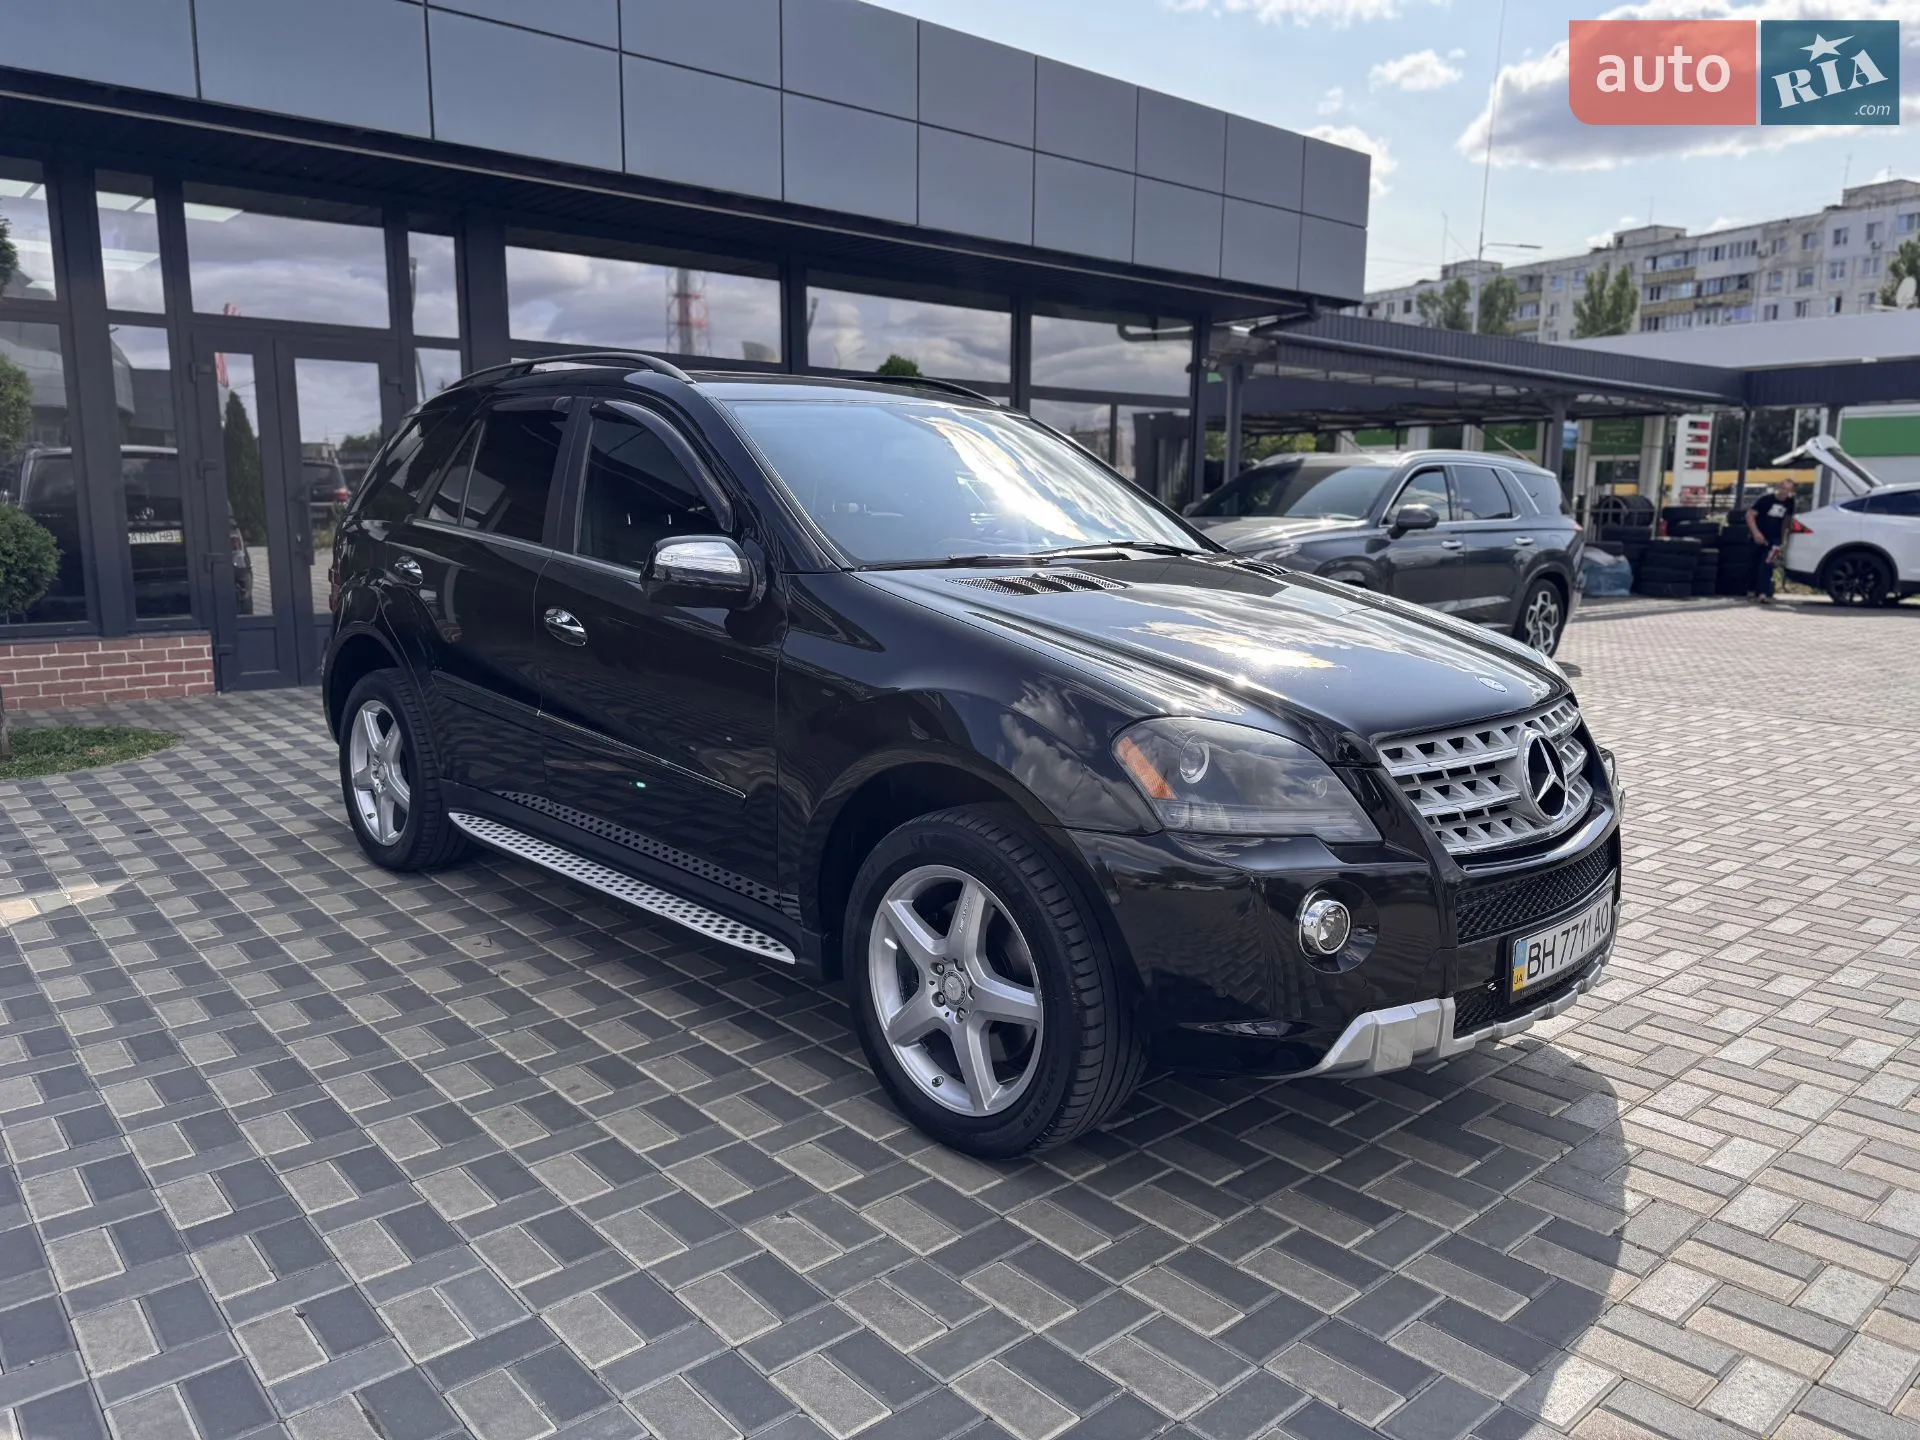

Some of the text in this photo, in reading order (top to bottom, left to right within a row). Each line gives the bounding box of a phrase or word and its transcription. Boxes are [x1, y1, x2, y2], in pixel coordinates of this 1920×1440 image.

[1527, 934, 1557, 980] BH
[1560, 914, 1592, 966] 7711
[1594, 901, 1609, 943] AO
